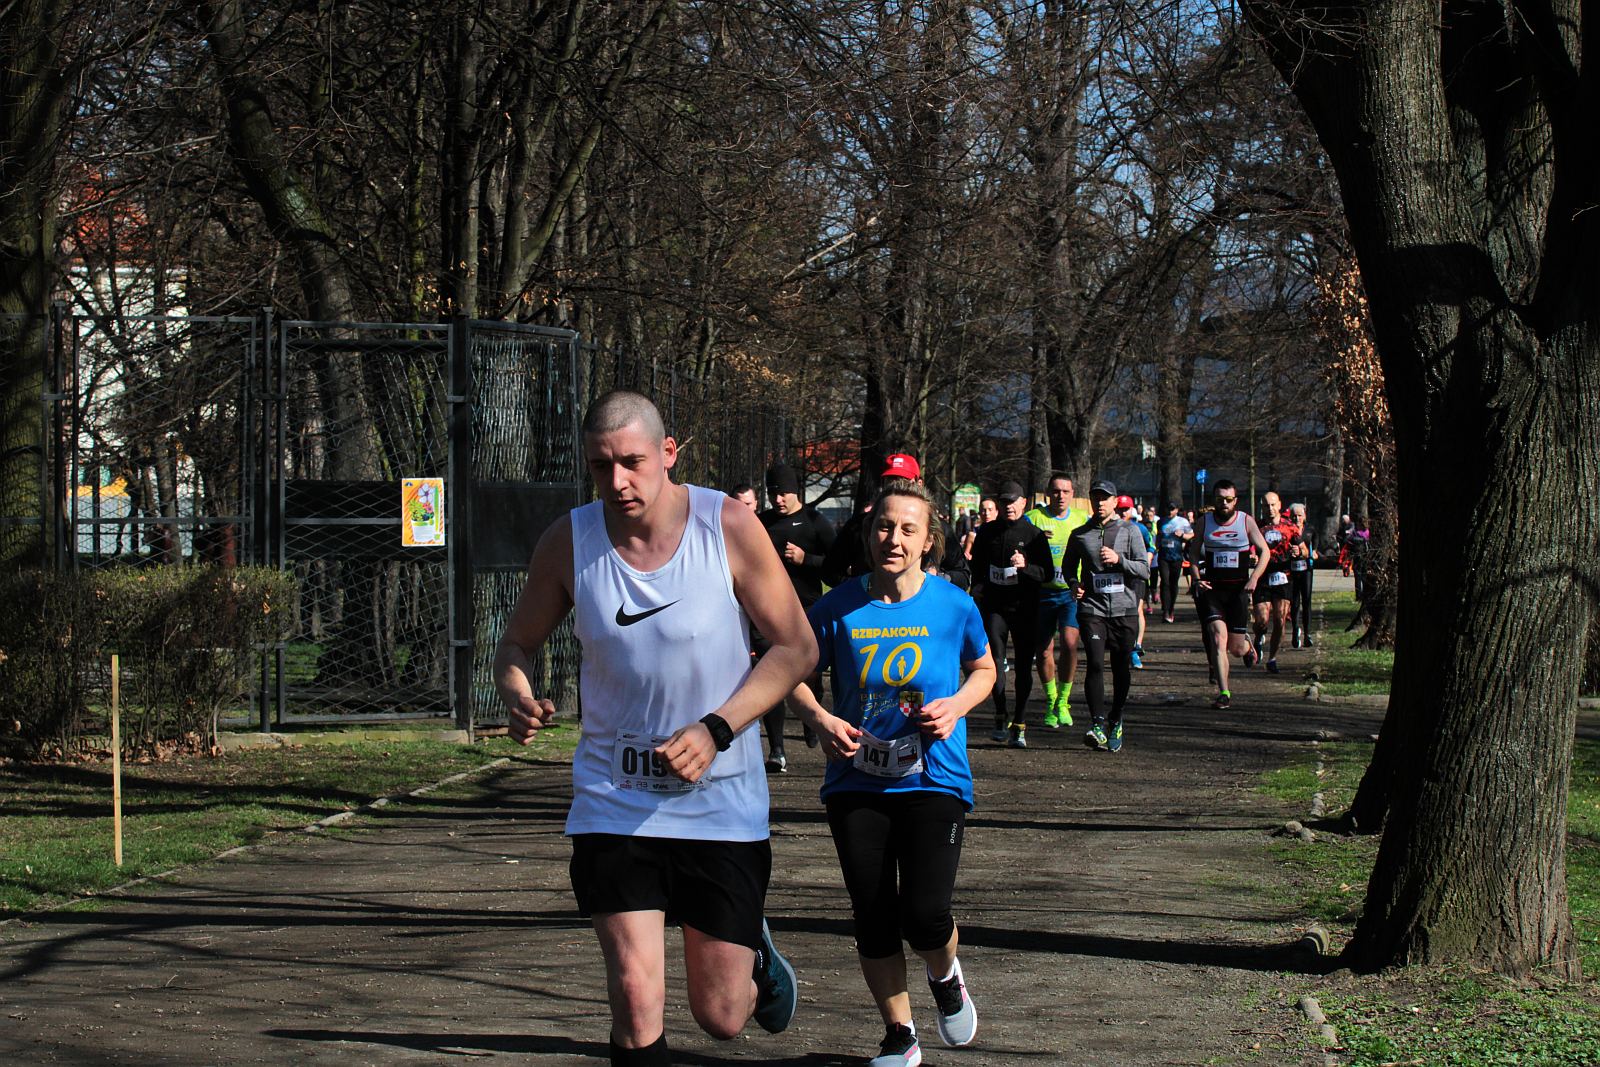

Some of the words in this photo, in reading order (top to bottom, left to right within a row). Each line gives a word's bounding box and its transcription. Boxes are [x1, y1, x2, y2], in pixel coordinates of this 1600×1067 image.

[1095, 579, 1113, 588] 098
[851, 626, 929, 640] RZEPAKOWA
[859, 641, 923, 689] 10
[862, 744, 890, 768] 147
